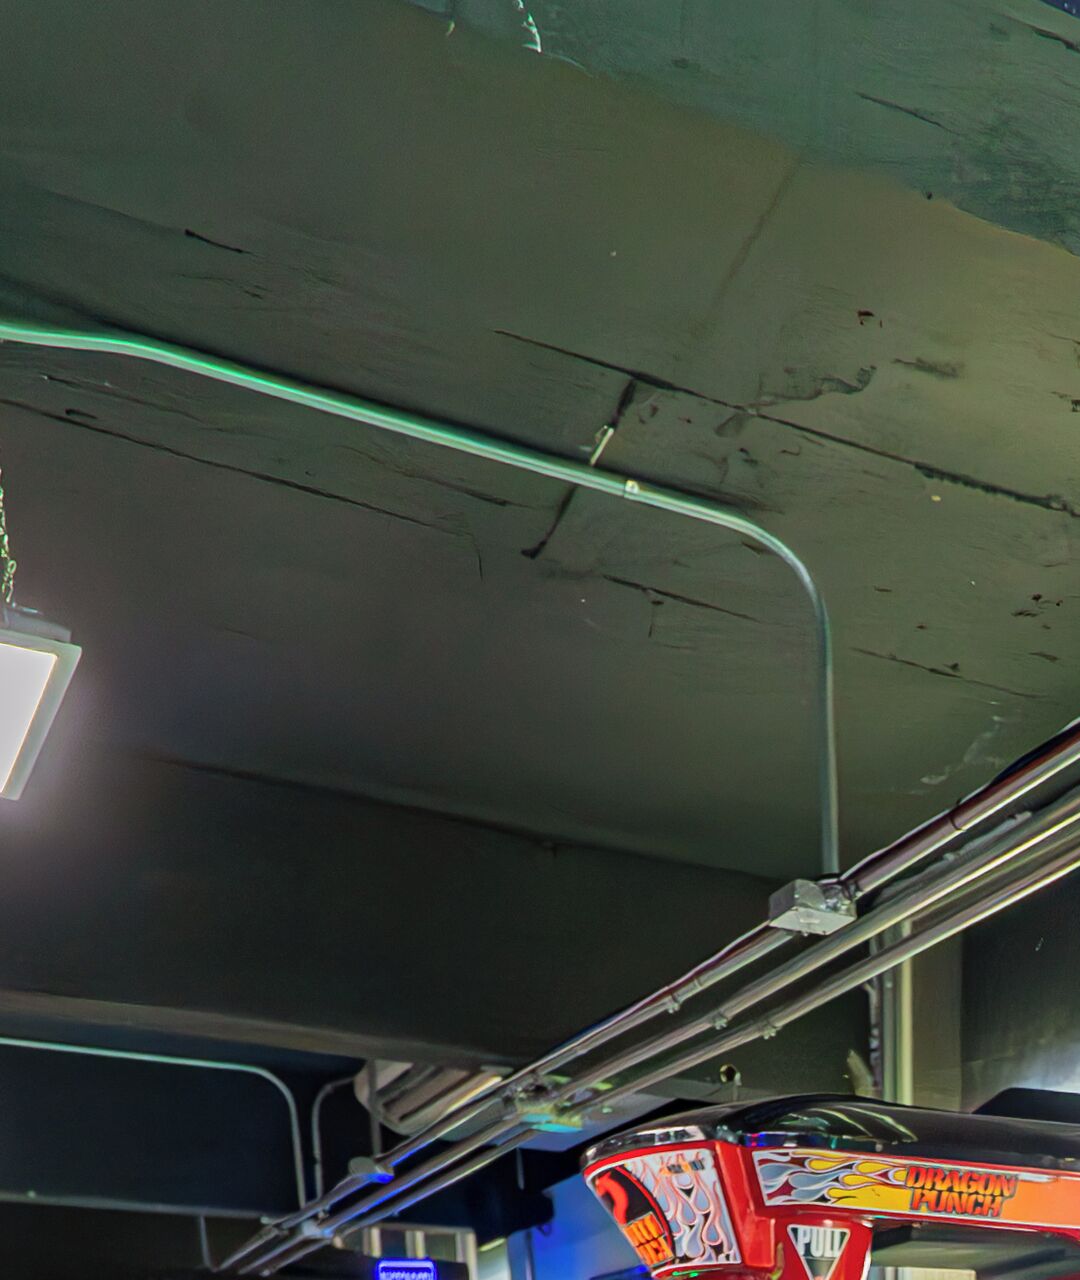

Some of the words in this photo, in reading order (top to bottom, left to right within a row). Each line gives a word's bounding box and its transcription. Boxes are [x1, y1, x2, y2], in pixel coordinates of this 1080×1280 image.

[906, 1165, 1018, 1197] DRAGON
[911, 1189, 1003, 1217] PUNCH
[797, 1227, 842, 1257] PULL
